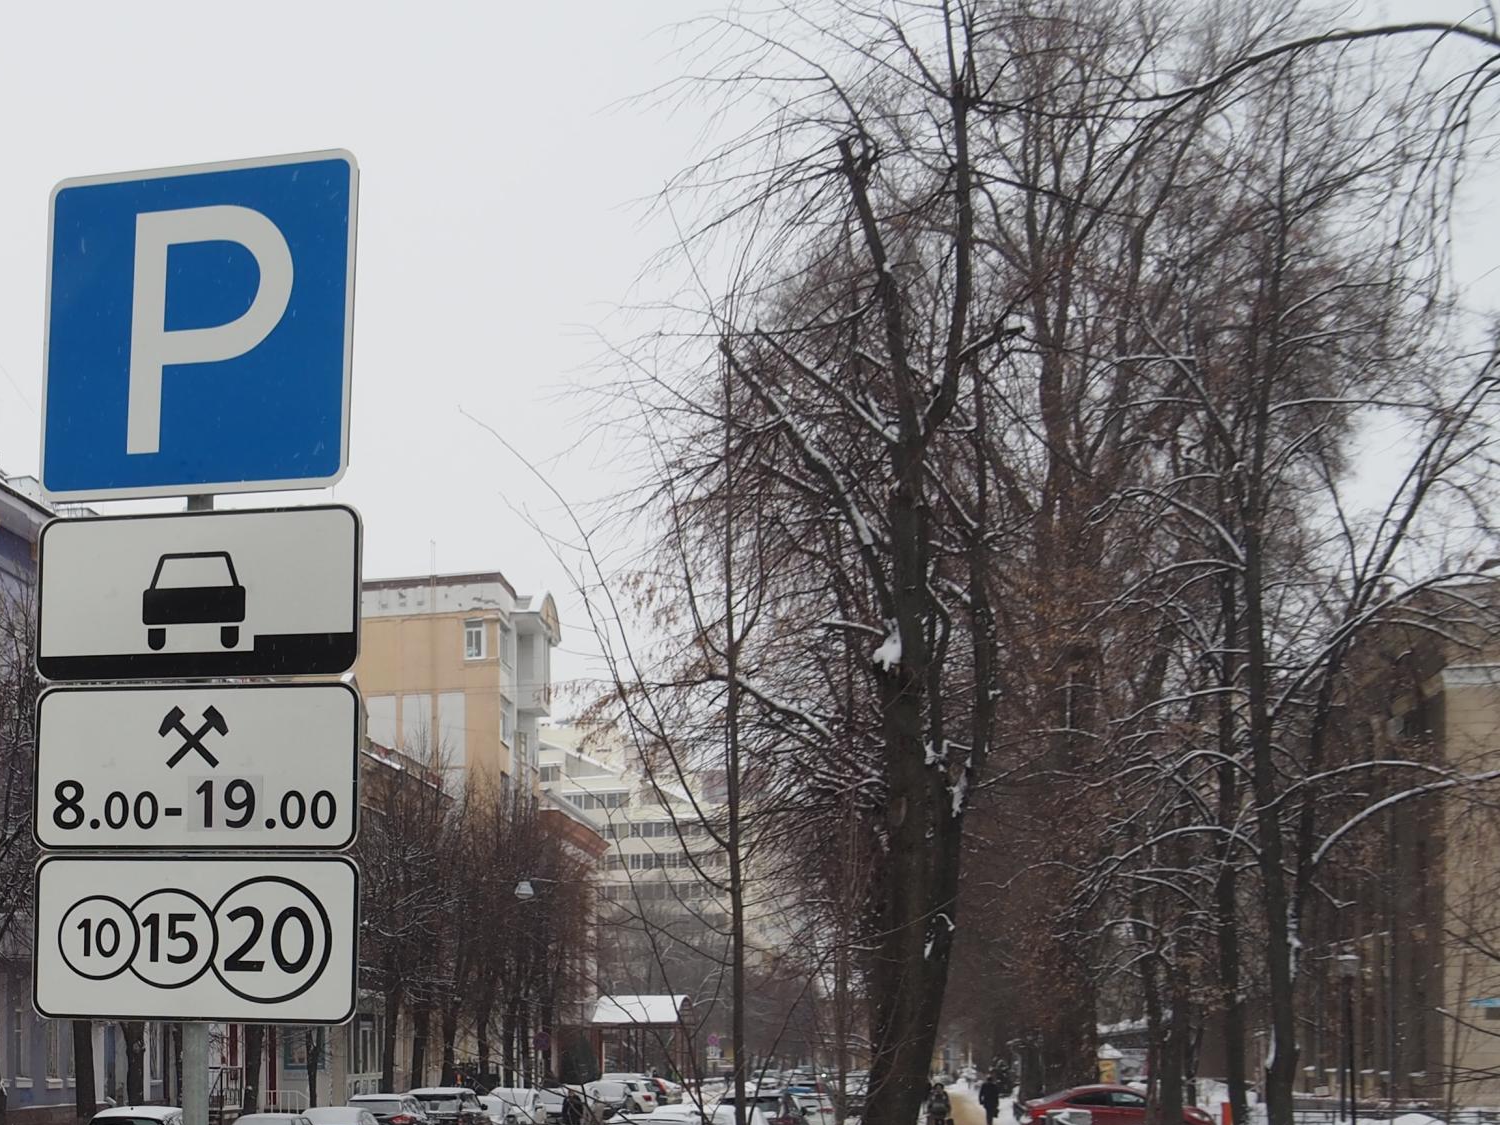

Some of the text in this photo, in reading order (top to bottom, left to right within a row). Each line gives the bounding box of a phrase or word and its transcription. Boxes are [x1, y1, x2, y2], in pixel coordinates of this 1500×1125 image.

[126, 204, 295, 456] P
[76, 905, 315, 975] 10 15 20
